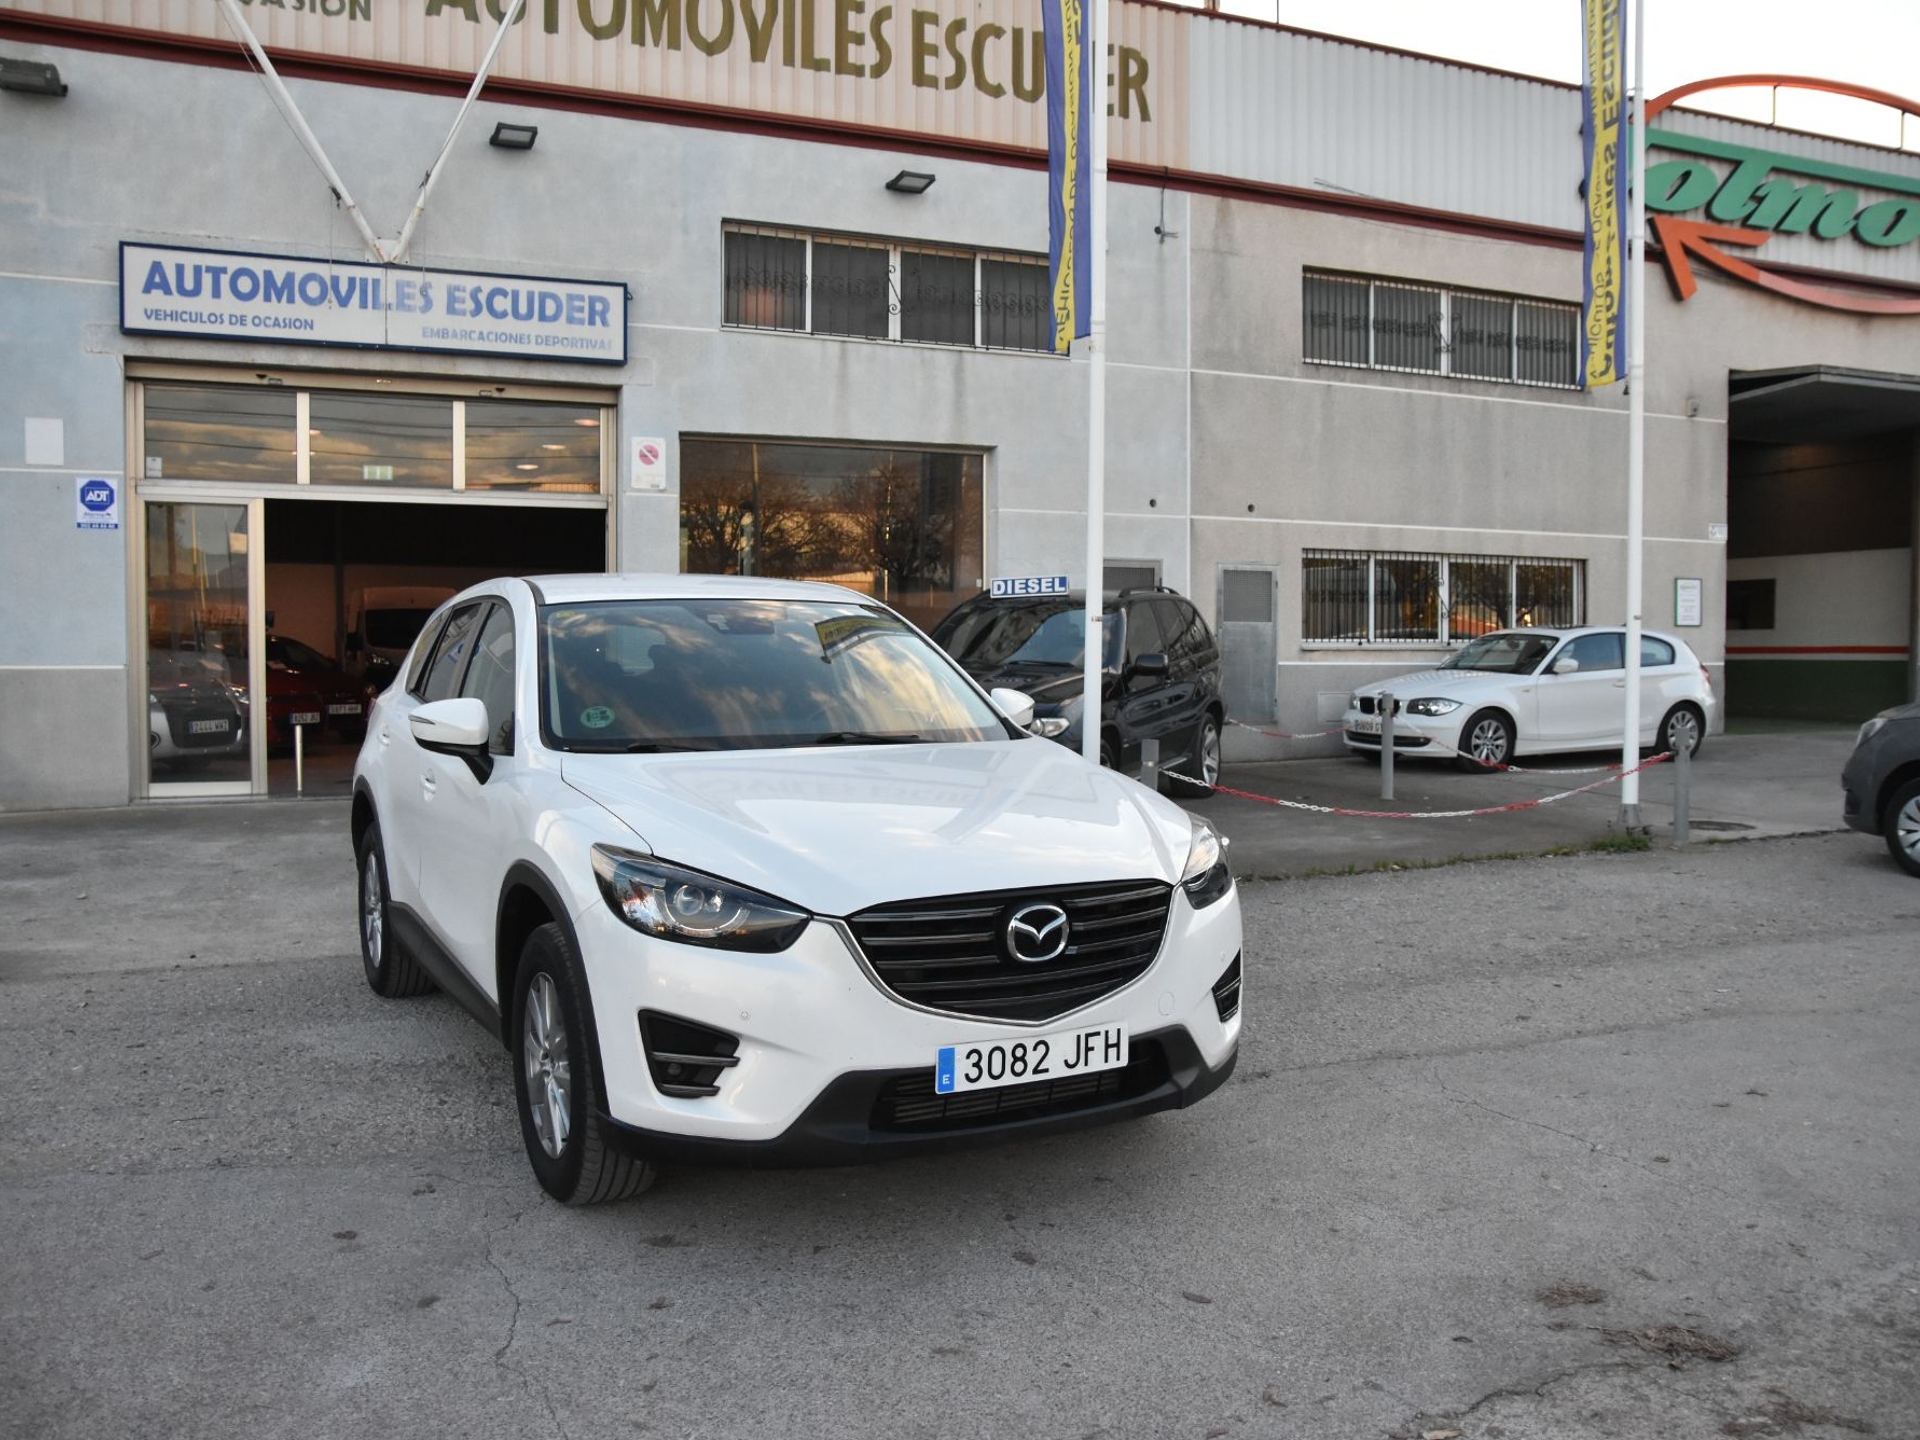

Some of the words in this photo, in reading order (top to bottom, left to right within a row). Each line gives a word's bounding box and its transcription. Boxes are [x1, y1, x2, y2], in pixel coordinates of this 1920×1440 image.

[426, 0, 892, 79] OMOVILES
[912, 9, 1151, 122] ESCUER
[142, 261, 433, 314] AUTOMOVILES
[446, 283, 611, 328] ESCUDER
[143, 308, 225, 326] VEHICULOS
[229, 314, 247, 327] DE
[251, 315, 315, 331] OCASION
[422, 326, 531, 345] EMBARCACIONES
[85, 490, 109, 502] ADT
[992, 577, 1066, 595] DIESEL
[964, 1039, 1050, 1083] 3082
[1063, 1027, 1121, 1069] JFH
[942, 1074, 950, 1084] E
